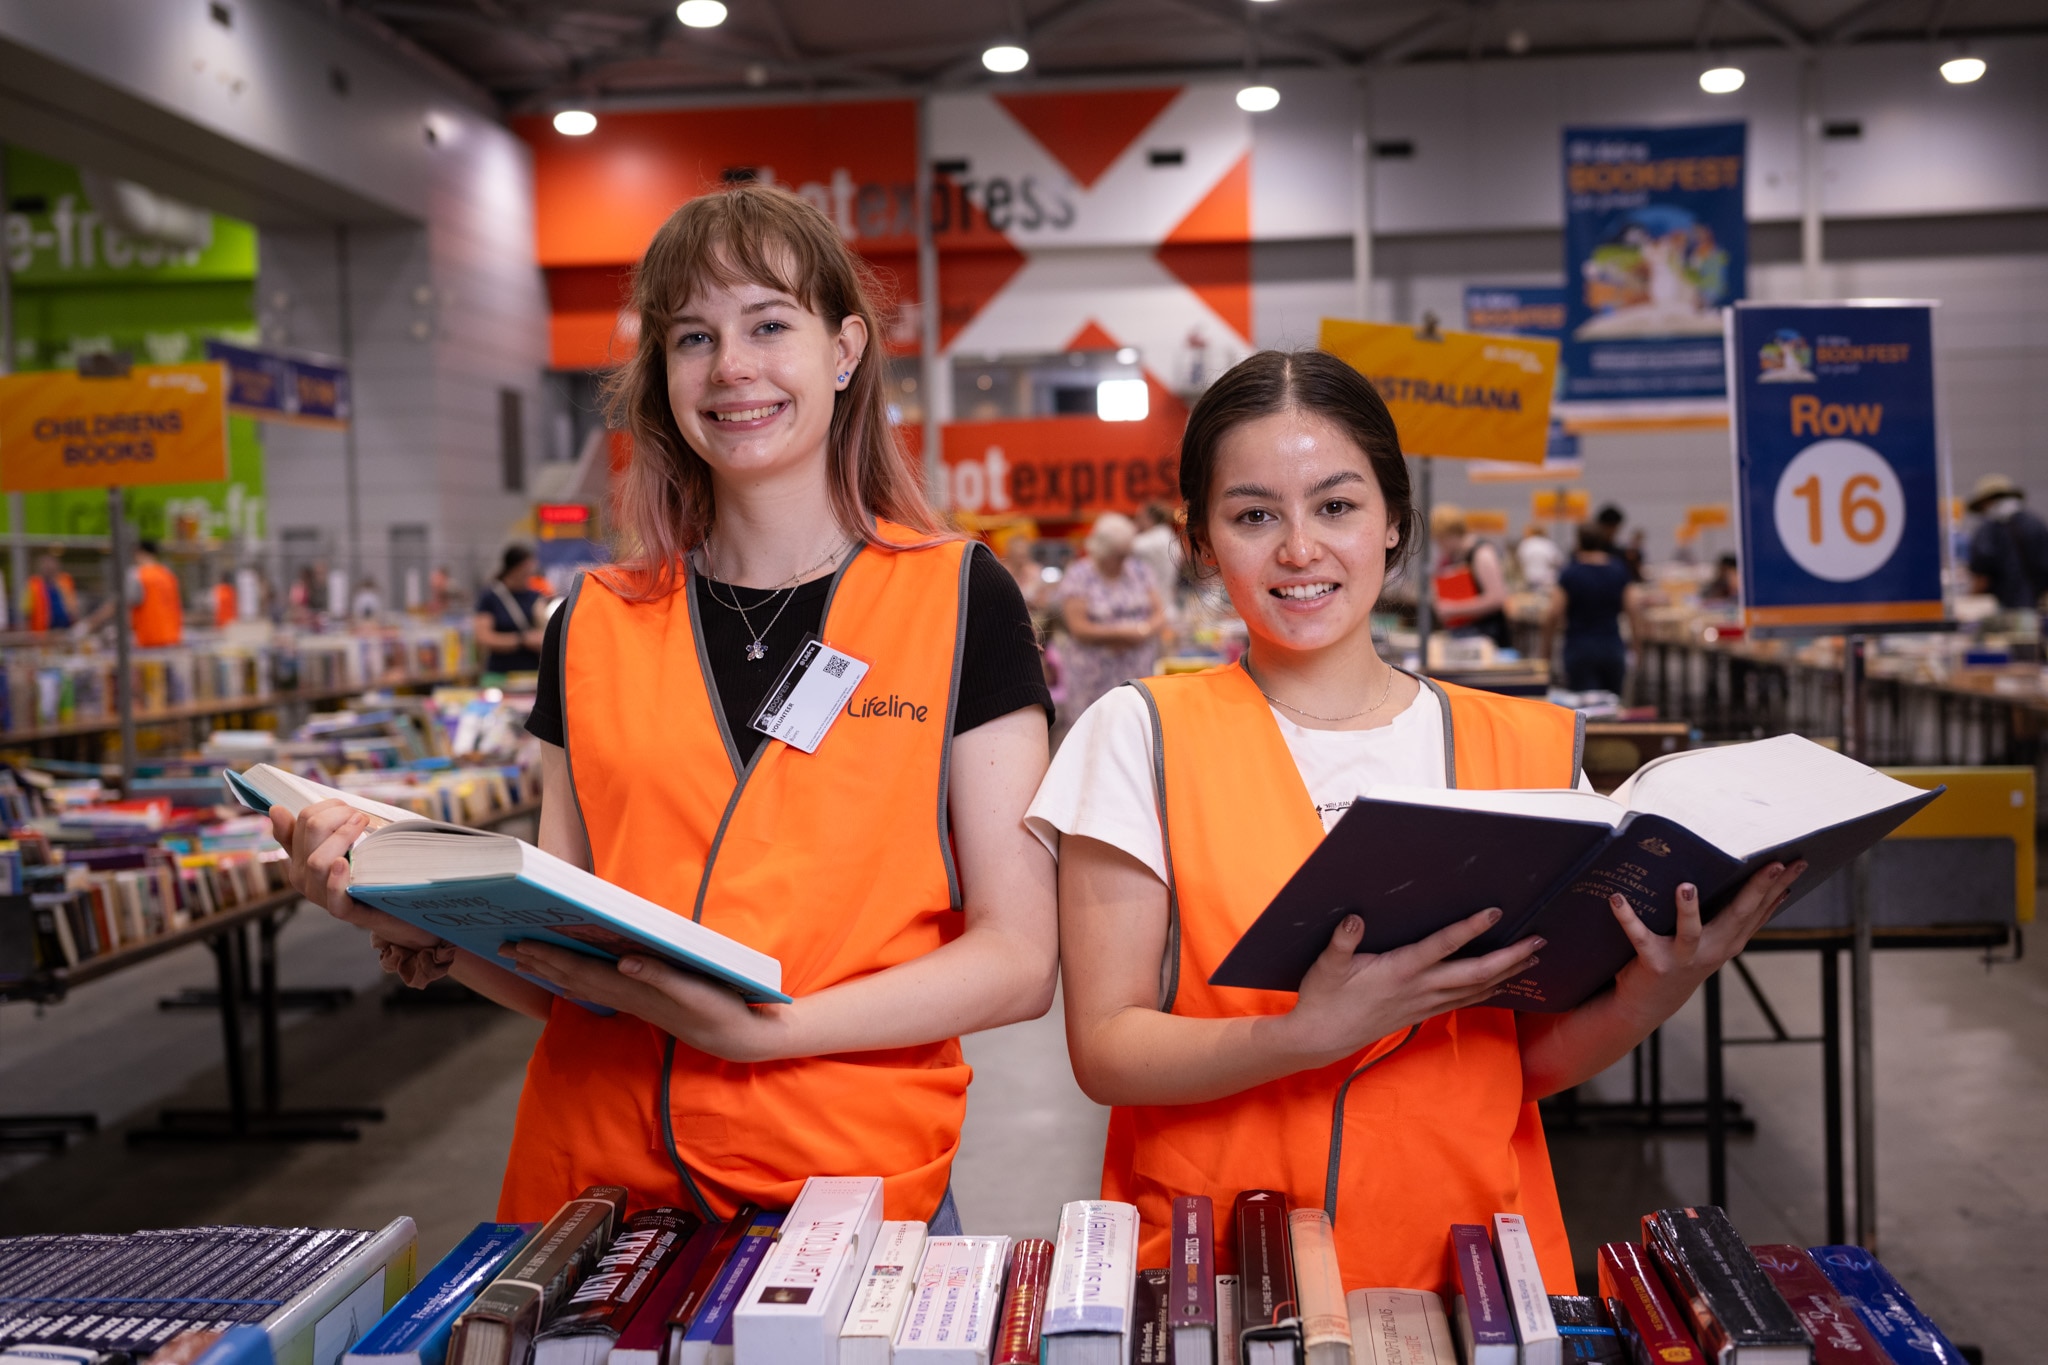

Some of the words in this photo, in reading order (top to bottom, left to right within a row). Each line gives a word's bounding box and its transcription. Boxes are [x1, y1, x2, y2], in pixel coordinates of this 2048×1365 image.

[1569, 156, 1740, 194] BOOKFEST
[1816, 343, 1910, 364] BOOKFEST
[1790, 394, 1883, 436] Row
[33, 410, 183, 443] CHILDRENS
[63, 441, 156, 467] BOOKS
[1793, 474, 1887, 546] 16
[768, 681, 791, 712] BOOKFEST
[770, 702, 795, 733] VOLUNTEER
[847, 694, 928, 722] Lifeline
[1621, 862, 1648, 876] ACTS
[1627, 872, 1642, 881] THE
[1592, 869, 1658, 897] PARLIAMENT
[382, 895, 504, 910] Growing
[423, 908, 585, 927] ORCHIDS
[1506, 983, 1535, 992] Volume
[515, 1263, 535, 1280] THE
[530, 1241, 554, 1269] HISTORY
[556, 1217, 577, 1240] HORSE
[572, 1202, 596, 1224] RACING
[597, 1229, 659, 1268] BLACK
[1185, 1237, 1199, 1263] ESTHETICS
[411, 1290, 446, 1319] Principles
[445, 1255, 480, 1291] Conservation
[474, 1239, 502, 1264] Biology
[568, 1272, 627, 1305] MEN
[921, 1287, 933, 1298] WITH
[947, 1287, 959, 1299] WITH
[917, 1300, 930, 1311] KIDS
[943, 1301, 956, 1311] KIDS
[912, 1313, 926, 1326] YOUR
[939, 1313, 953, 1326] YOUR
[908, 1328, 921, 1340] HELP
[936, 1328, 949, 1340] HELP
[964, 1329, 977, 1341] HELP
